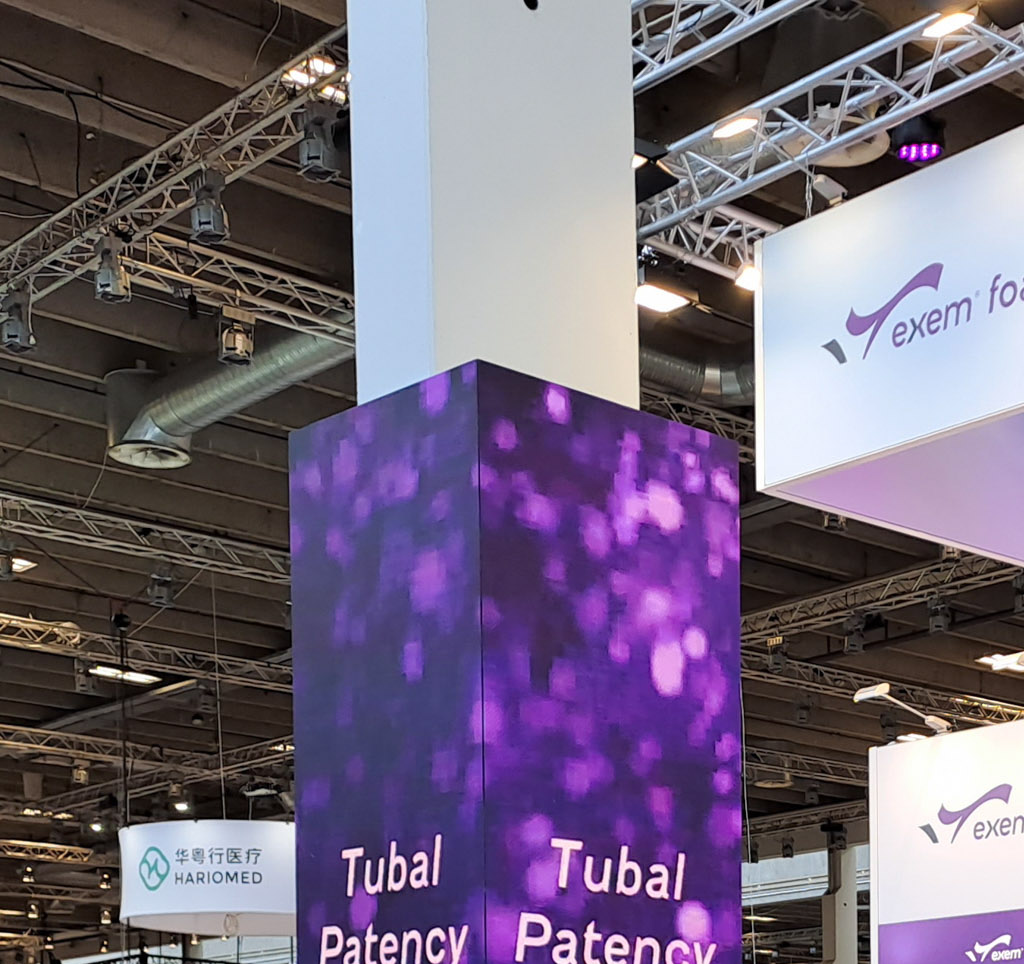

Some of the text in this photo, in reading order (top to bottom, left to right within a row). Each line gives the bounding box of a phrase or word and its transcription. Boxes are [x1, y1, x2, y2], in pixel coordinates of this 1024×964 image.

[174, 847, 263, 866] 华粤行医疗
[341, 834, 442, 897] Tubal
[550, 837, 686, 901] Tubal
[174, 871, 263, 885] HARIOMED
